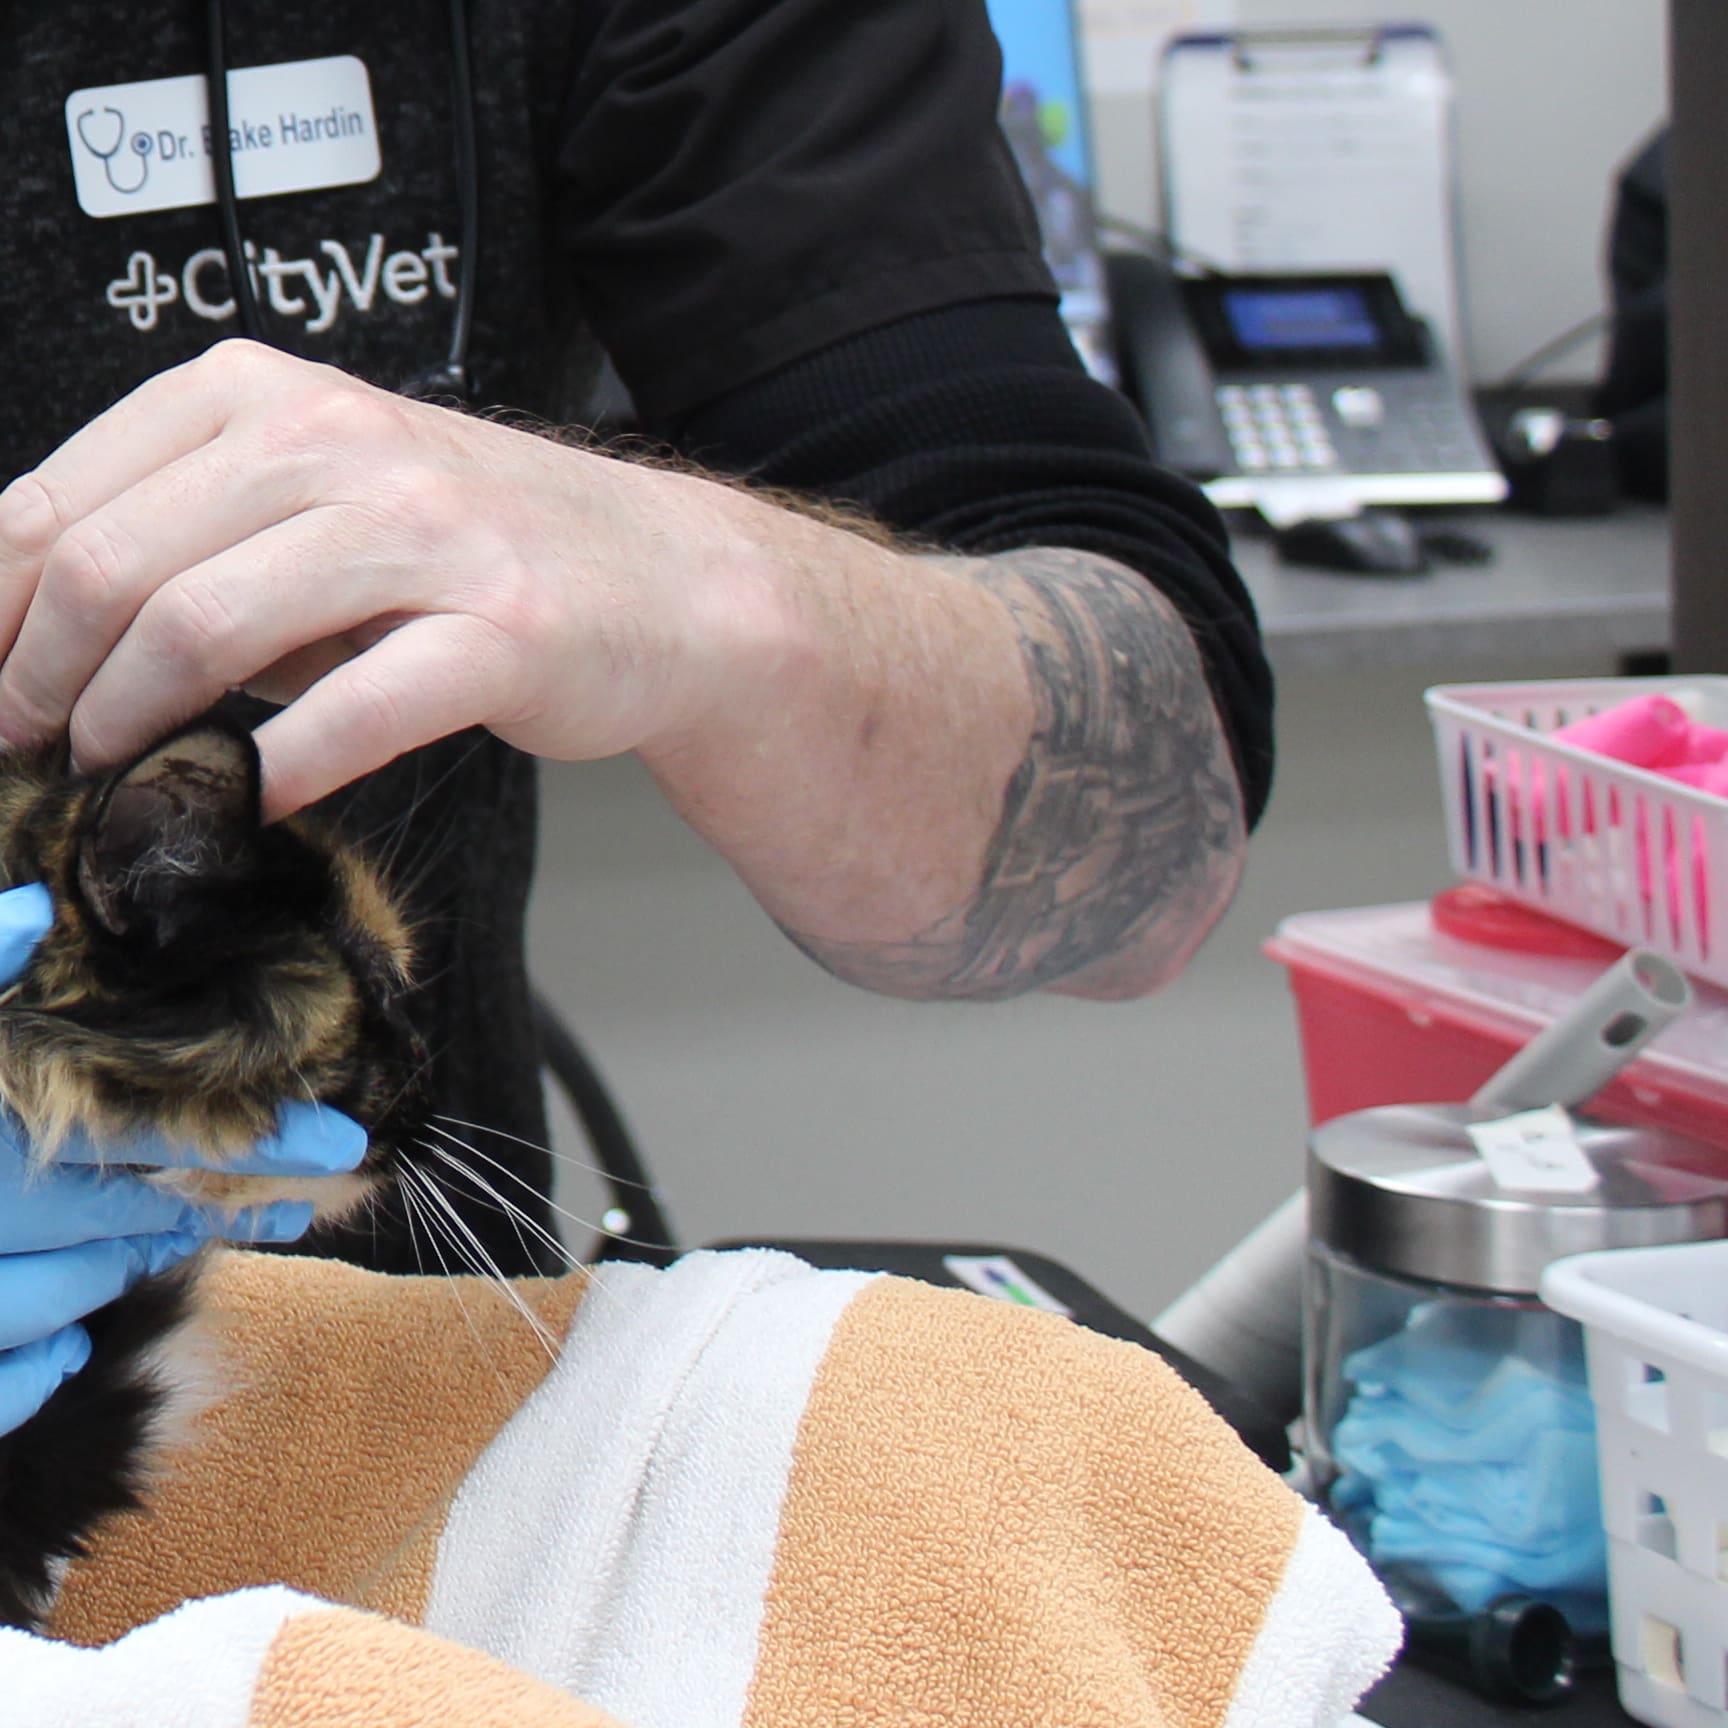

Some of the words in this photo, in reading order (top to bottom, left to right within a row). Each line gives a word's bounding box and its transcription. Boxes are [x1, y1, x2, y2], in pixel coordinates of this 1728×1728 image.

[157, 129, 194, 161] Dr.
[278, 107, 364, 146] Hardin
[182, 232, 459, 334] CityVet
